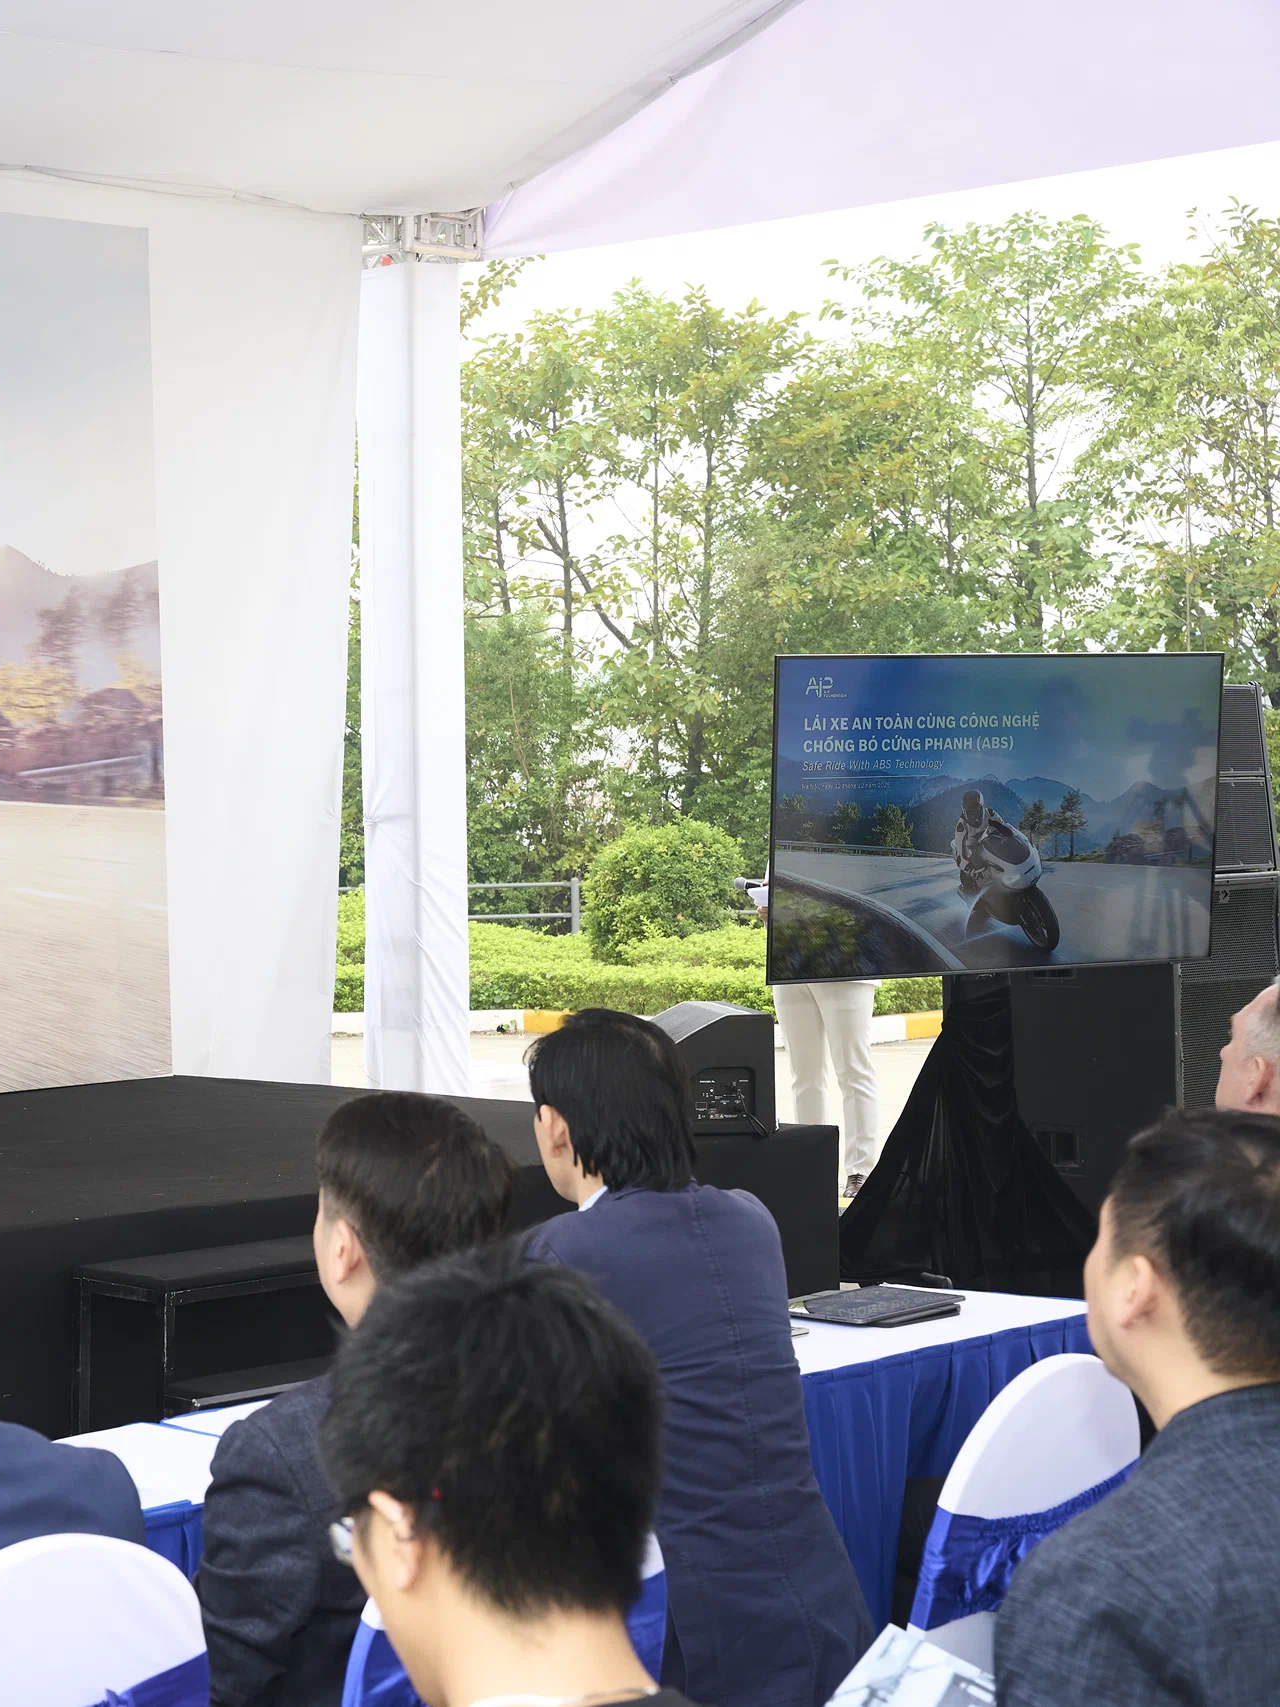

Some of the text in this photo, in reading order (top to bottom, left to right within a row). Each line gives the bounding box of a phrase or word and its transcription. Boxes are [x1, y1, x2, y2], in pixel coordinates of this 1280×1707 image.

[804, 710, 1040, 731] LÁI XE AN TOÀN CÙNG CÔNG NGHỆ
[803, 734, 1014, 753] CHỐNG BÓ CỨNG PHANH (ABS)
[802, 758, 945, 771] Safe Ride With ABS Technology
